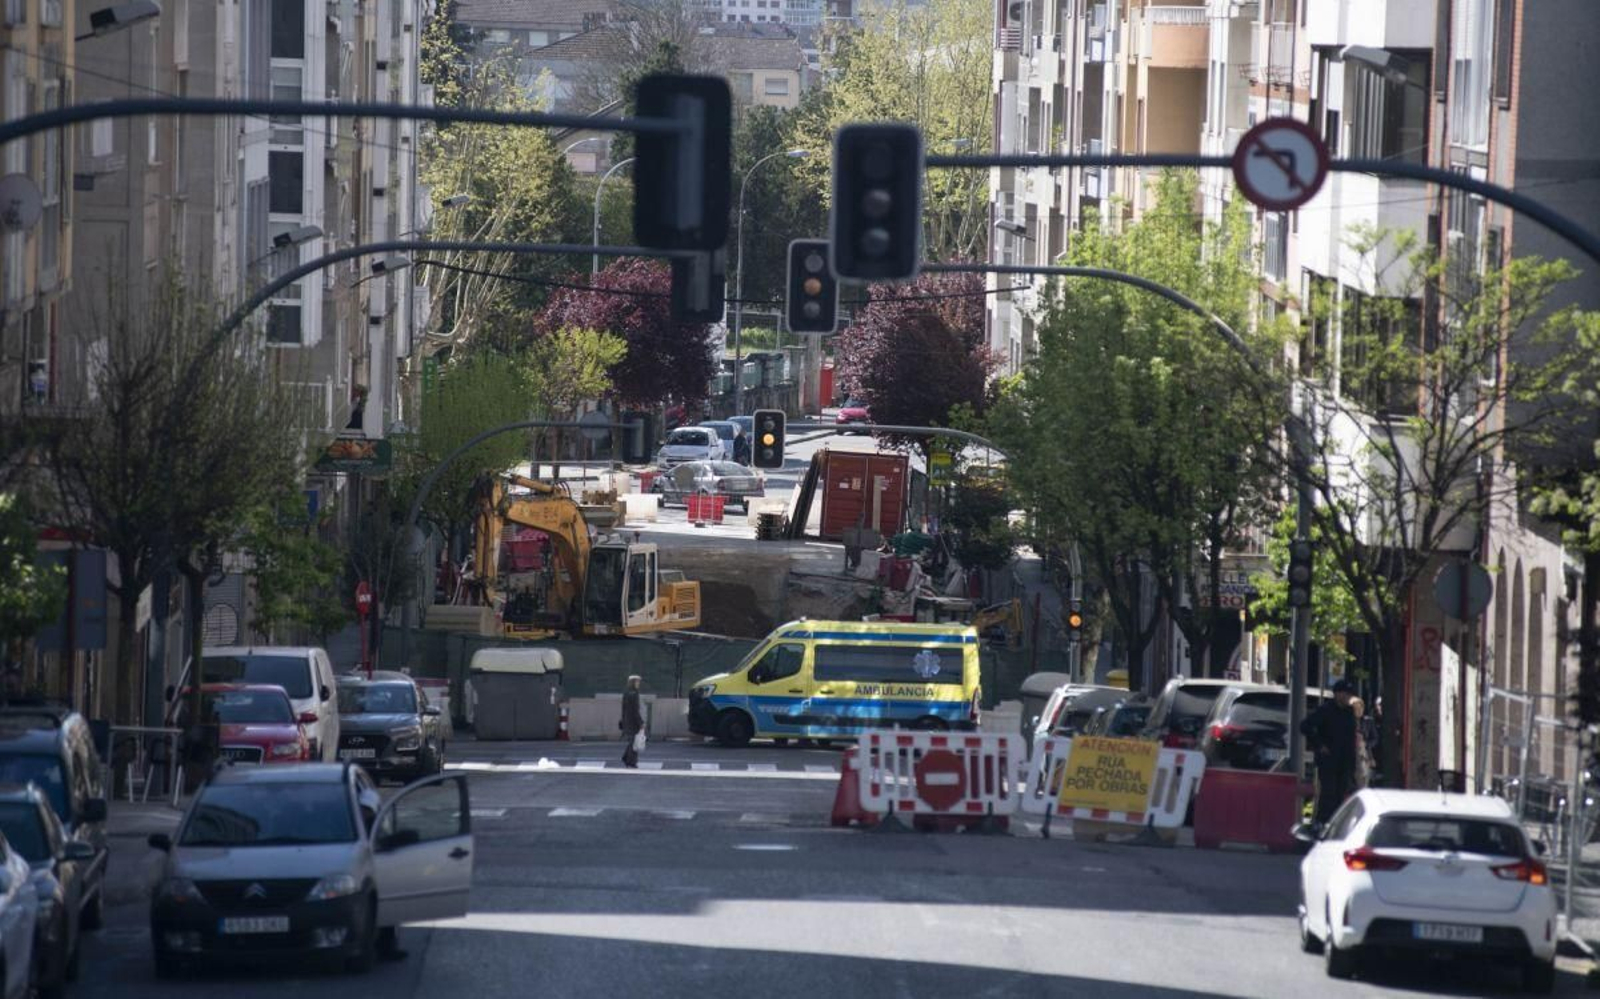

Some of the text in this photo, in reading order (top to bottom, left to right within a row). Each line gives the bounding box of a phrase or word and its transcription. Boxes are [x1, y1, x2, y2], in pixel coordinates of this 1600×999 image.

[854, 684, 934, 697] AMBULANCIA
[1098, 755, 1126, 768] RUA
[1076, 766, 1142, 782] PECHADA
[1066, 778, 1149, 795] POR OBRAS
